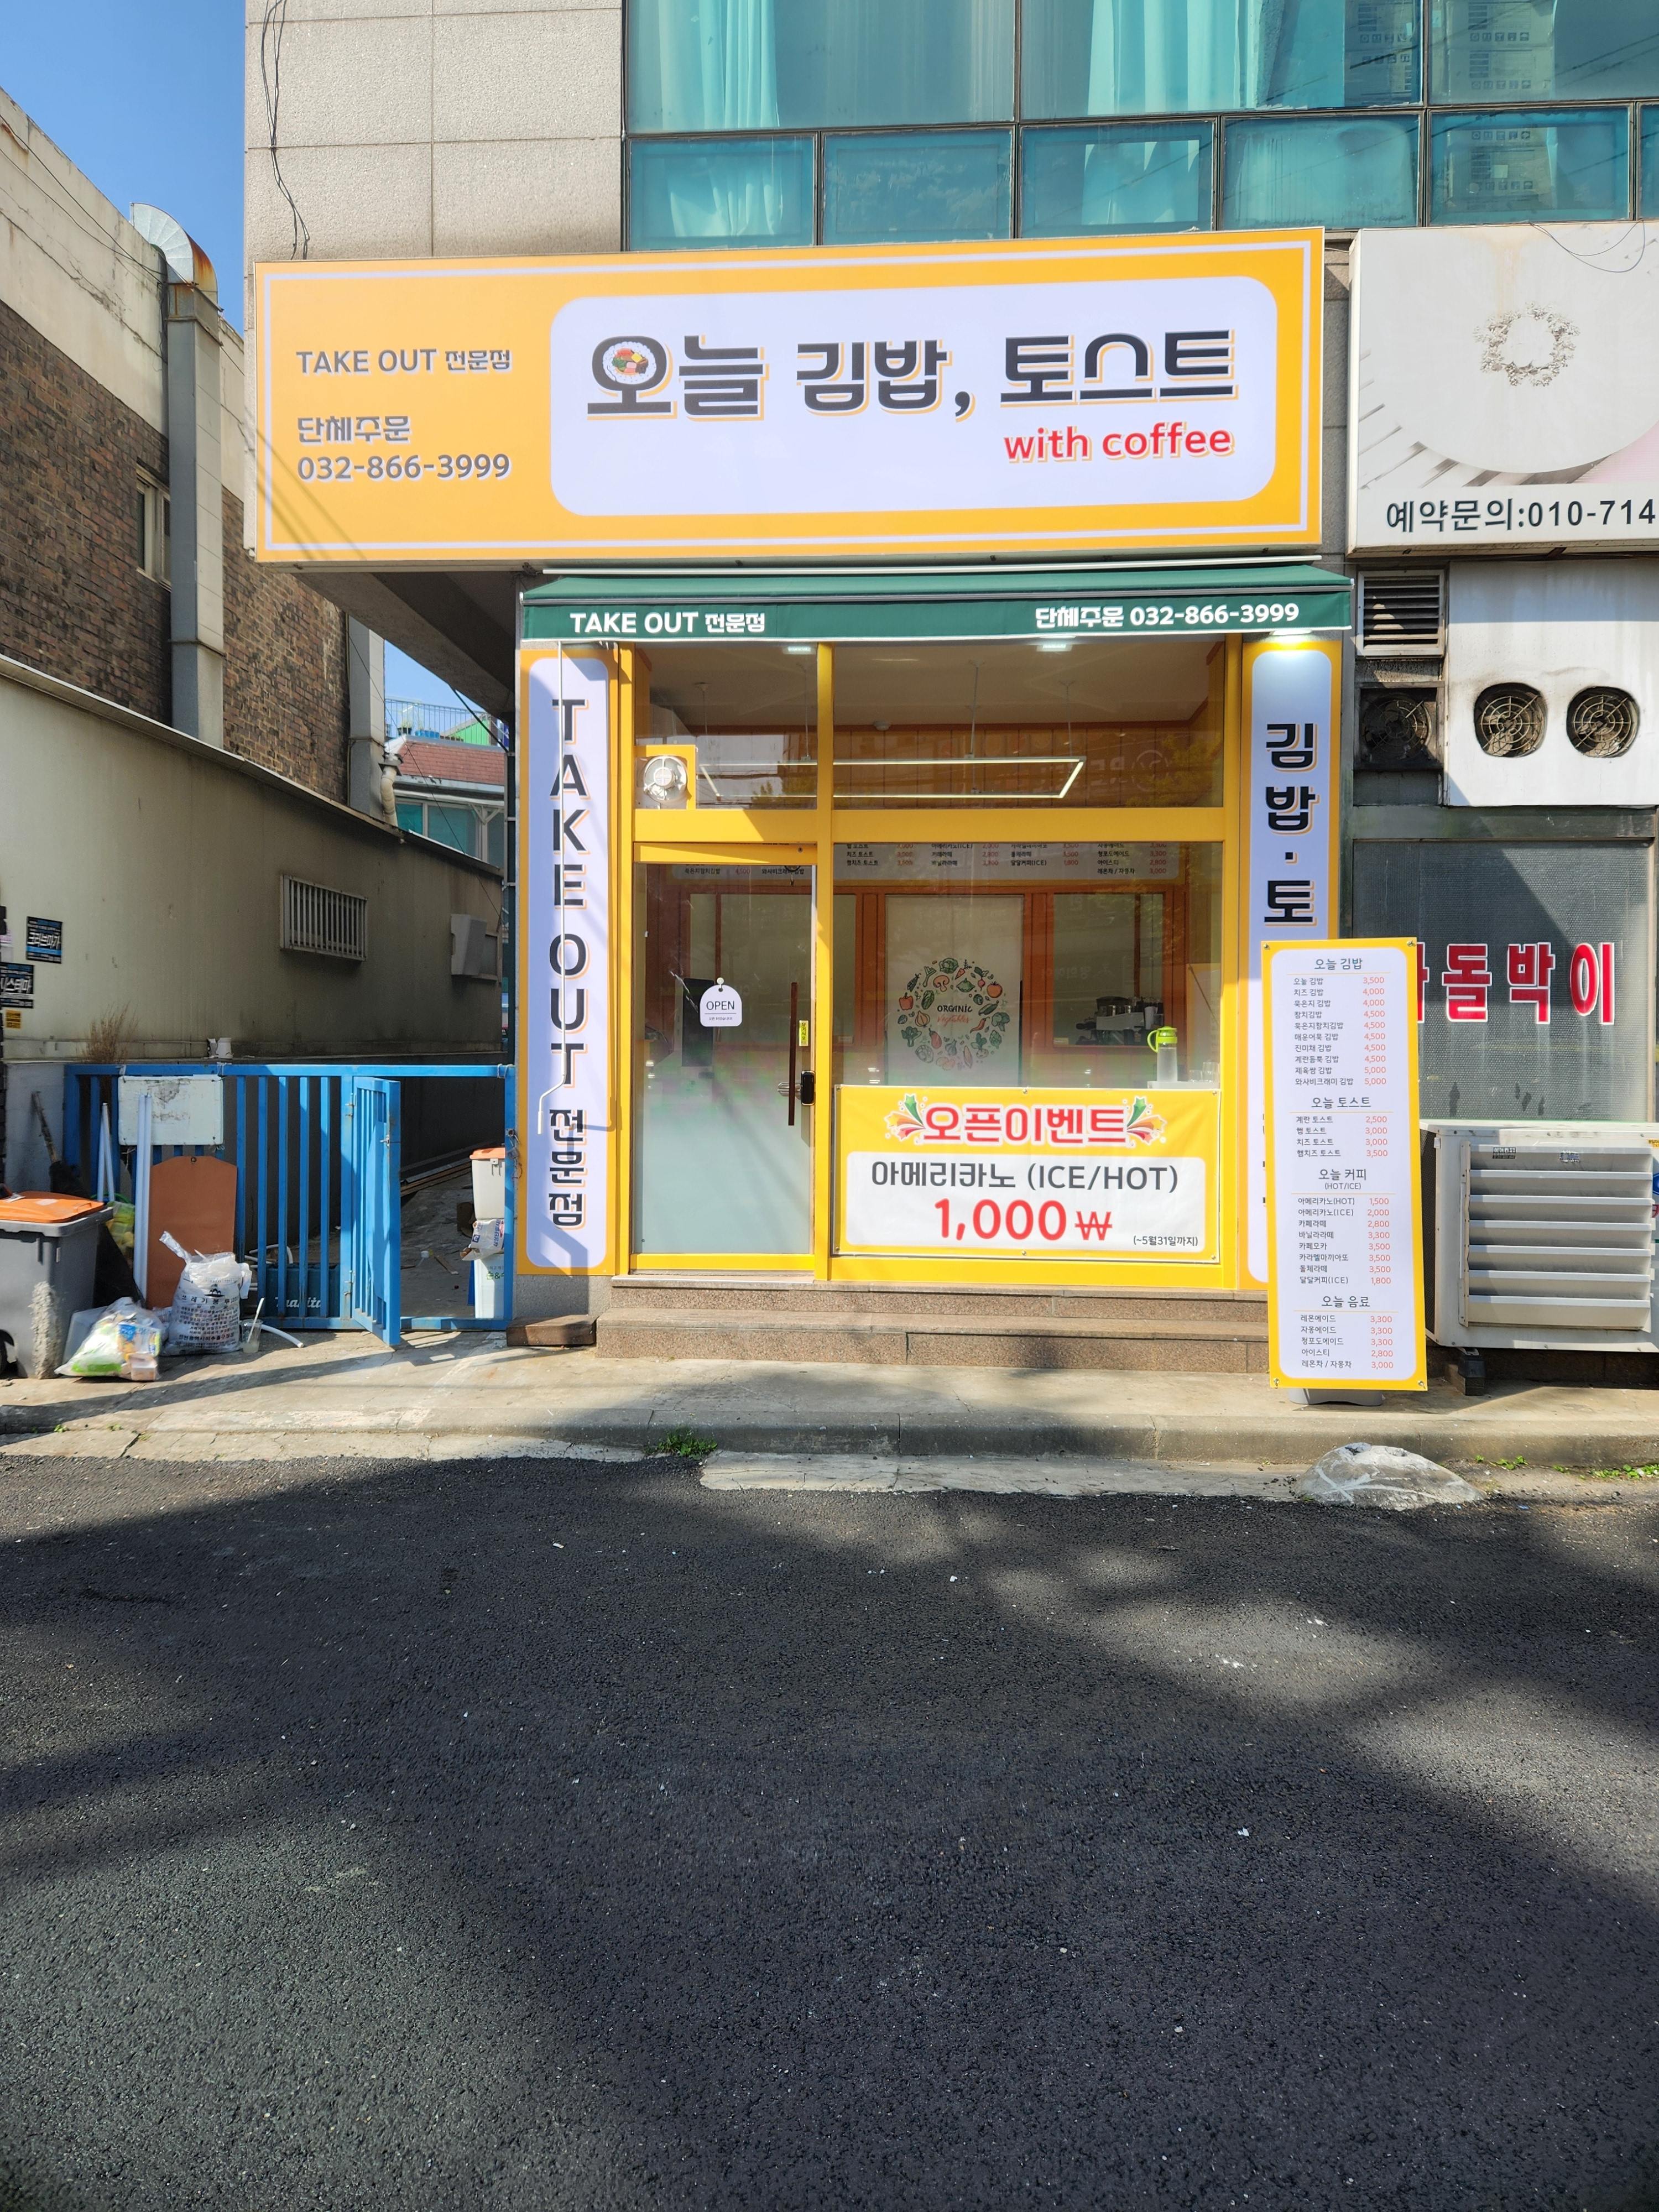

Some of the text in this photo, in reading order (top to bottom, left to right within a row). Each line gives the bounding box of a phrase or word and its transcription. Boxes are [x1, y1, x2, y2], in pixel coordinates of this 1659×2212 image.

[296, 349, 512, 375] TAKE OUT 전문점
[587, 334, 766, 418] 오늘
[1000, 330, 1237, 405] 토스트
[298, 415, 411, 445] 단체주문
[1005, 422, 1233, 461] with coffee
[298, 453, 512, 481] 032-866-3999
[1036, 603, 1300, 628] 단체주문 032-866-3999
[570, 611, 765, 633] TAKE OUT 전문점
[549, 698, 588, 1229] TAKE OUT 전문점
[1314, 958, 1363, 971] 오늘 김밥
[1363, 977, 1385, 985] 3,500
[1363, 988, 1385, 997] 4,000
[706, 1000, 734, 1010] OPEN
[1363, 999, 1385, 1008] 4,000
[1364, 1010, 1385, 1019] 4,500
[1364, 1033, 1386, 1041] 4,500
[1364, 1044, 1386, 1052] 4,500
[1364, 1055, 1386, 1063] 4,500
[1295, 1078, 1338, 1086] 와사비크래미
[1365, 1078, 1386, 1086] 5,000
[1311, 1097, 1371, 1109] 오늘 토스트
[922, 1104, 1128, 1144] 오픈이벤트
[1365, 1116, 1387, 1124] 2,500
[1365, 1127, 1387, 1135] 3,000
[1365, 1138, 1388, 1147] 3,000
[1366, 1150, 1388, 1158] 3,500
[871, 1161, 1178, 1193] 아메리카노 (ICE/HOT)
[1318, 1168, 1366, 1181] 오늘 커피
[1369, 1198, 1389, 1206] 1,500
[1367, 1209, 1390, 1217] 2,000
[1368, 1220, 1390, 1229] 2,800
[1368, 1232, 1390, 1240] 3,300
[1133, 1235, 1198, 1247] (~5월31일까지)
[1369, 1243, 1390, 1251] 3,500
[1369, 1254, 1391, 1262] 3,500
[1300, 1265, 1391, 1274] 돌체라떼 3,500
[1371, 1277, 1391, 1285] 1,800
[1322, 1296, 1370, 1308] 오늘 음료
[1370, 1316, 1392, 1324] 3,300
[1370, 1327, 1392, 1335] 3,300
[1301, 1337, 1393, 1347] 청포도에이드 3,300
[1371, 1350, 1393, 1358] 2,800
[1302, 1360, 1323, 1368] 레몬차
[1330, 1360, 1352, 1369] 자몽차
[1371, 1361, 1394, 1370] 3,000
